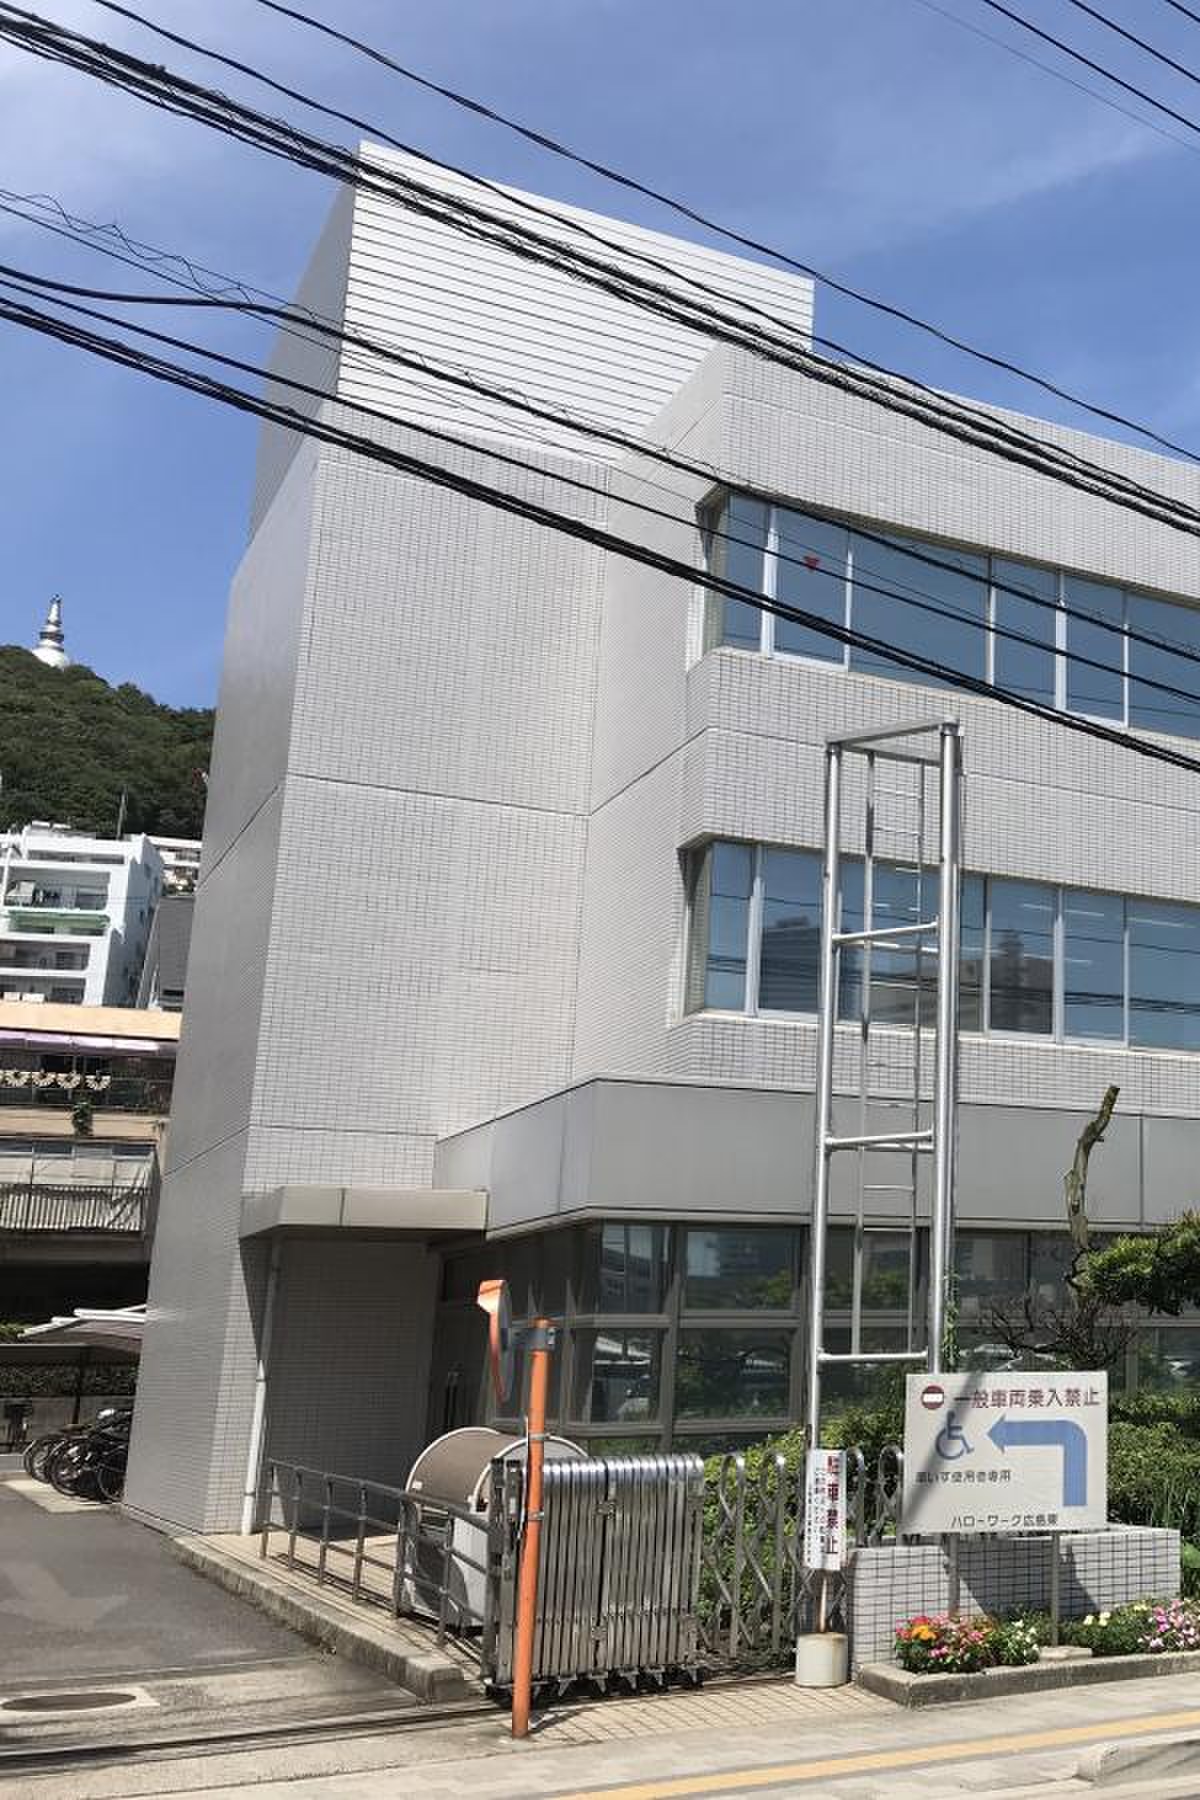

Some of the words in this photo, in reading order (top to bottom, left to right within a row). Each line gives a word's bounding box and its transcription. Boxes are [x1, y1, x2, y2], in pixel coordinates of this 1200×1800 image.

[953, 1386, 1100, 1409] 一般車両乗入禁止
